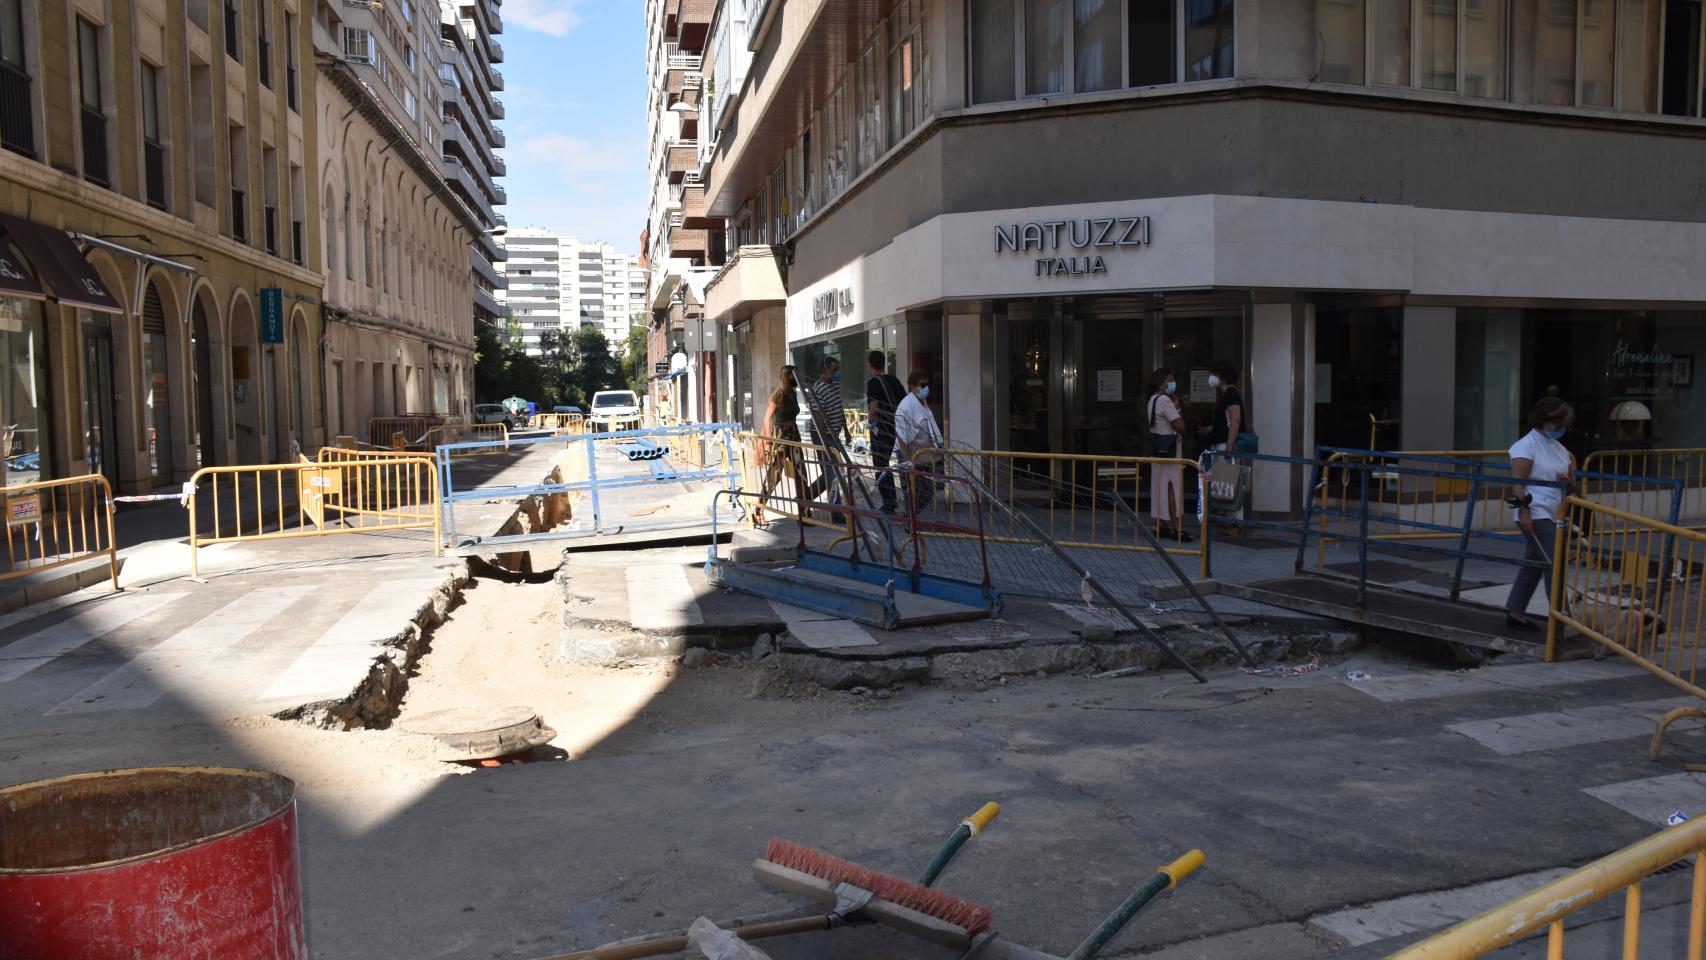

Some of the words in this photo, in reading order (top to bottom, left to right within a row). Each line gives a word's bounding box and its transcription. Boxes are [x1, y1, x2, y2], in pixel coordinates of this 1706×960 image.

[995, 216, 1151, 253] NATUZZI
[1035, 255, 1107, 277] ITALIA
[267, 290, 276, 342] BERGAMOTA
